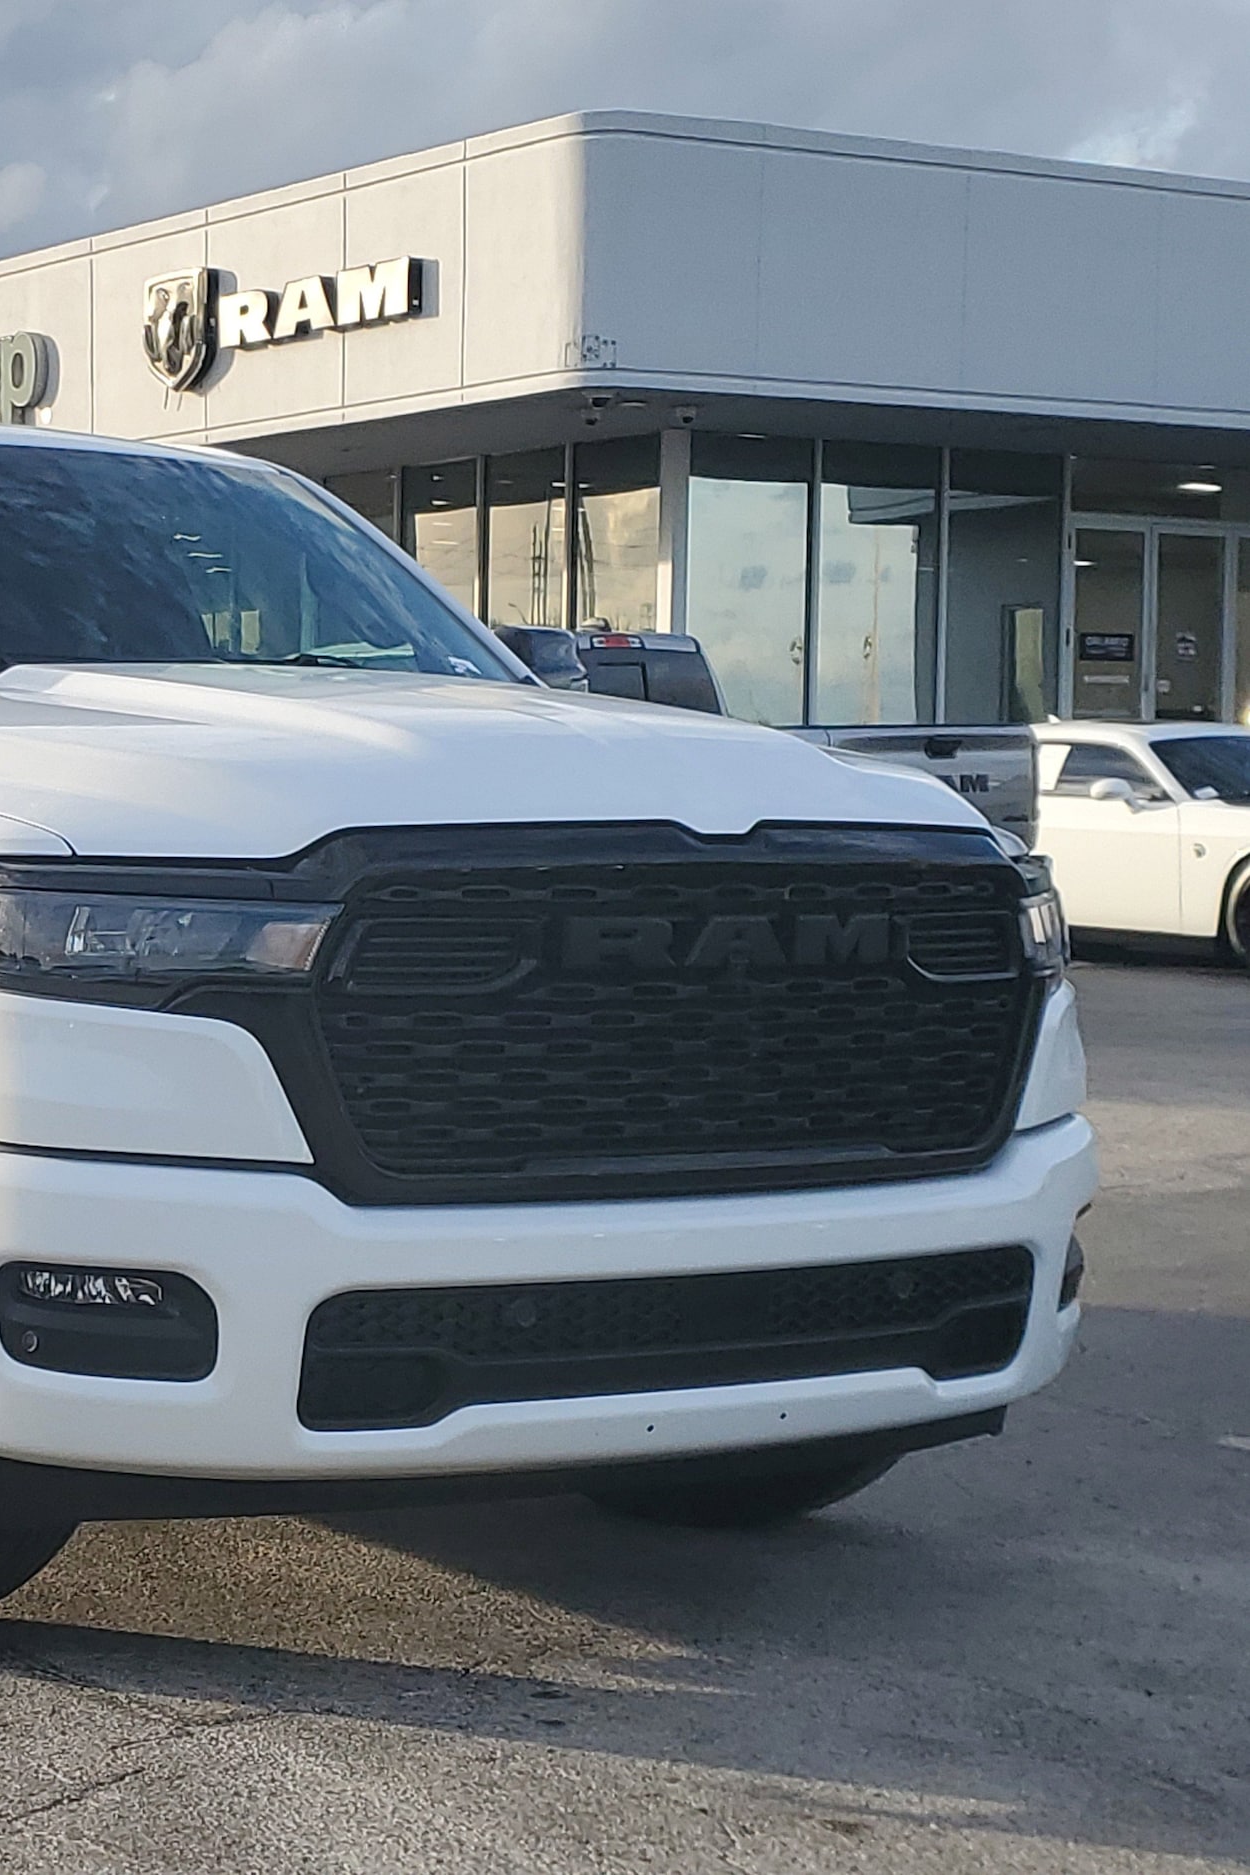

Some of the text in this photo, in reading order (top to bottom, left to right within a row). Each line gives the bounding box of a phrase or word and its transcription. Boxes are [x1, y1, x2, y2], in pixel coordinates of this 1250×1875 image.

[219, 255, 422, 350] RAM
[934, 774, 990, 793] AM
[561, 913, 891, 967] RAM
